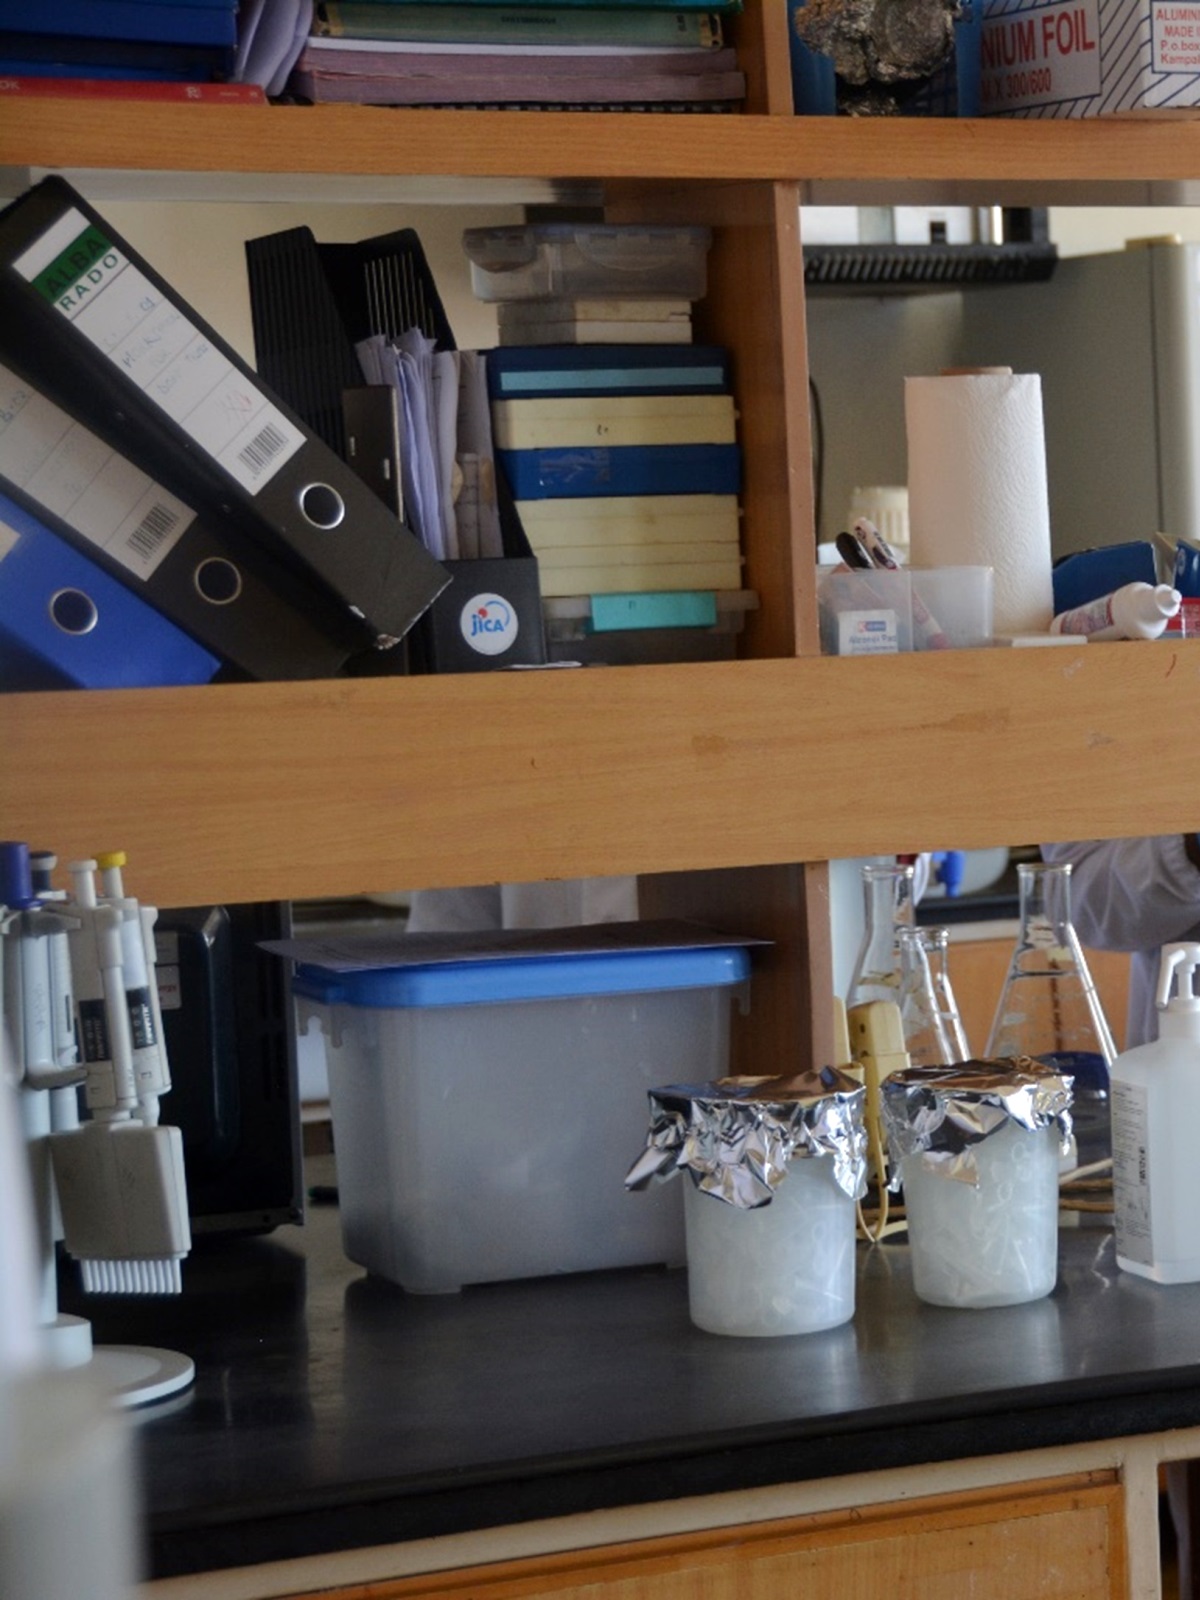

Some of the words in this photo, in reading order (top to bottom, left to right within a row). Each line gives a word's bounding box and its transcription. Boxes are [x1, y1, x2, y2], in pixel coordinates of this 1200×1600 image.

[1042, 8, 1095, 59] FOIL
[1164, 26, 1194, 38] MADE
[45, 237, 106, 297] ALBA
[59, 254, 118, 311] RADO
